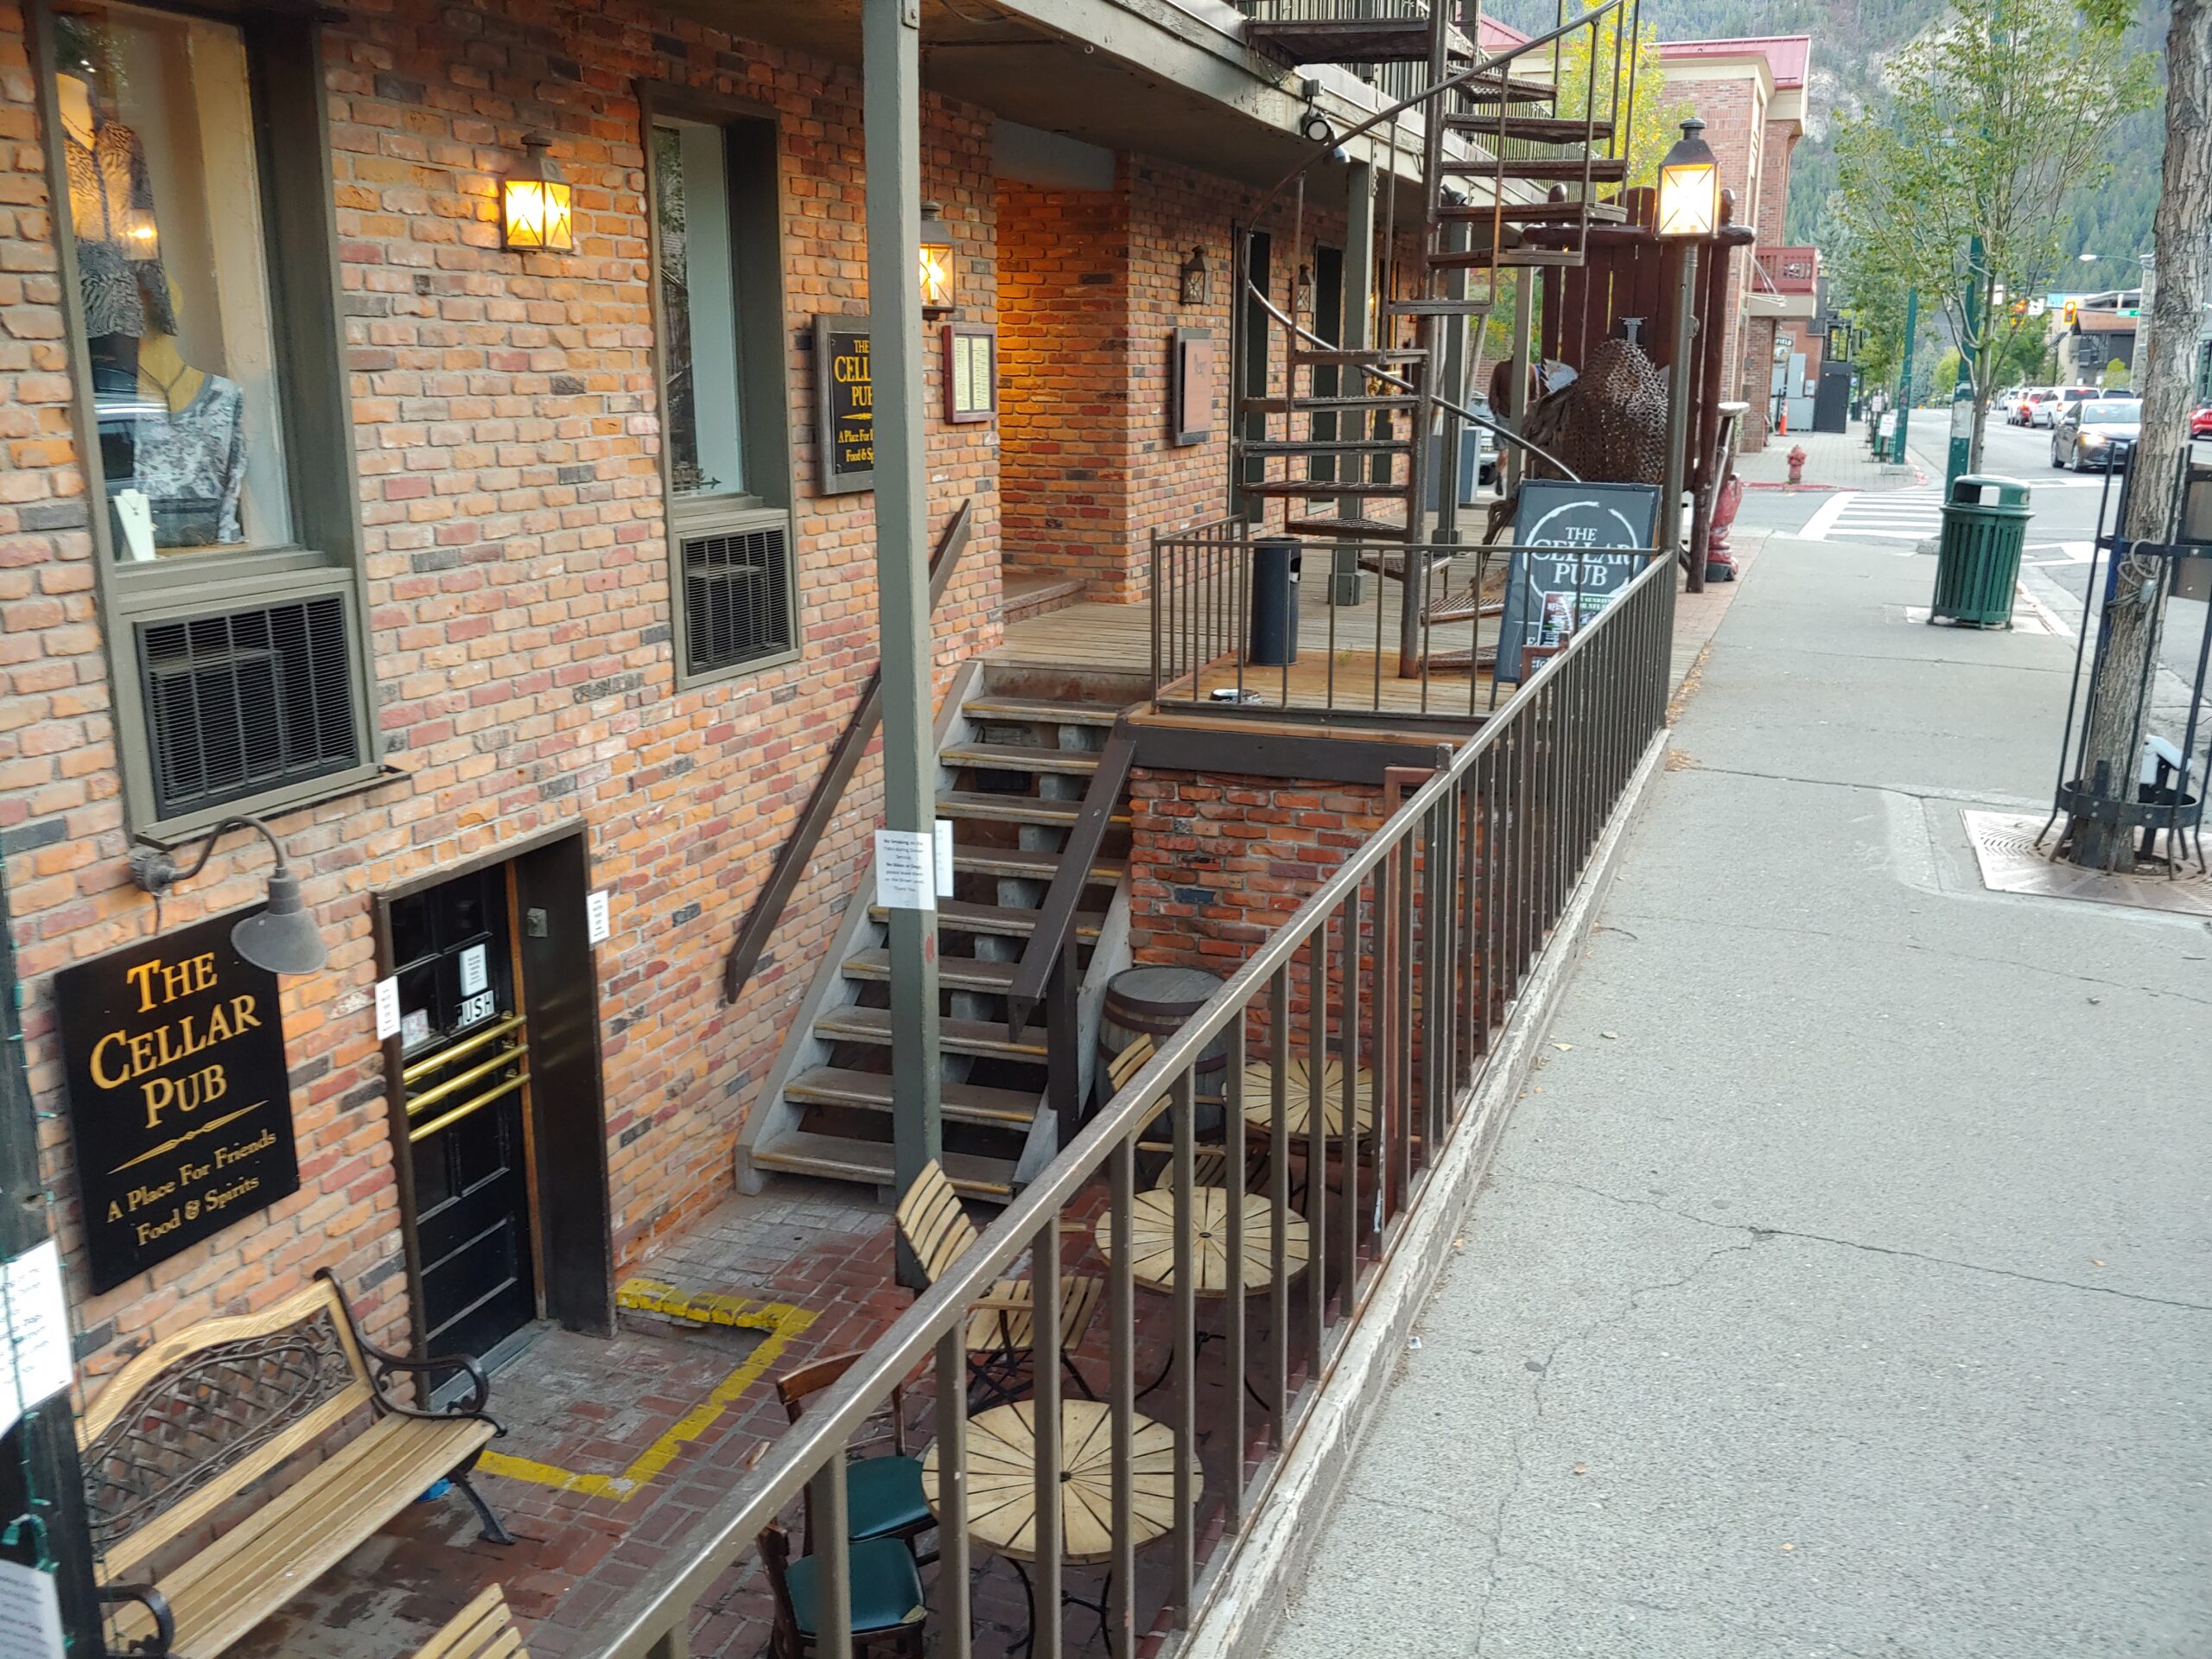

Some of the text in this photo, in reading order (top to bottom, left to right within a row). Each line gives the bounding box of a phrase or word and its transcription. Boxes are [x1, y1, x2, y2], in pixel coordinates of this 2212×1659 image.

[834, 355, 872, 383] CELL
[853, 340, 870, 353] THE
[1531, 539, 1631, 565] CELLAR
[1565, 526, 1598, 541] THE
[1553, 563, 1608, 586] PUB
[126, 951, 218, 1014] THE
[90, 994, 262, 1090] CELLAR
[140, 1064, 228, 1128] PUB
[106, 1128, 276, 1223] A Place For Friends
[136, 1175, 259, 1246] Food & Spirits
